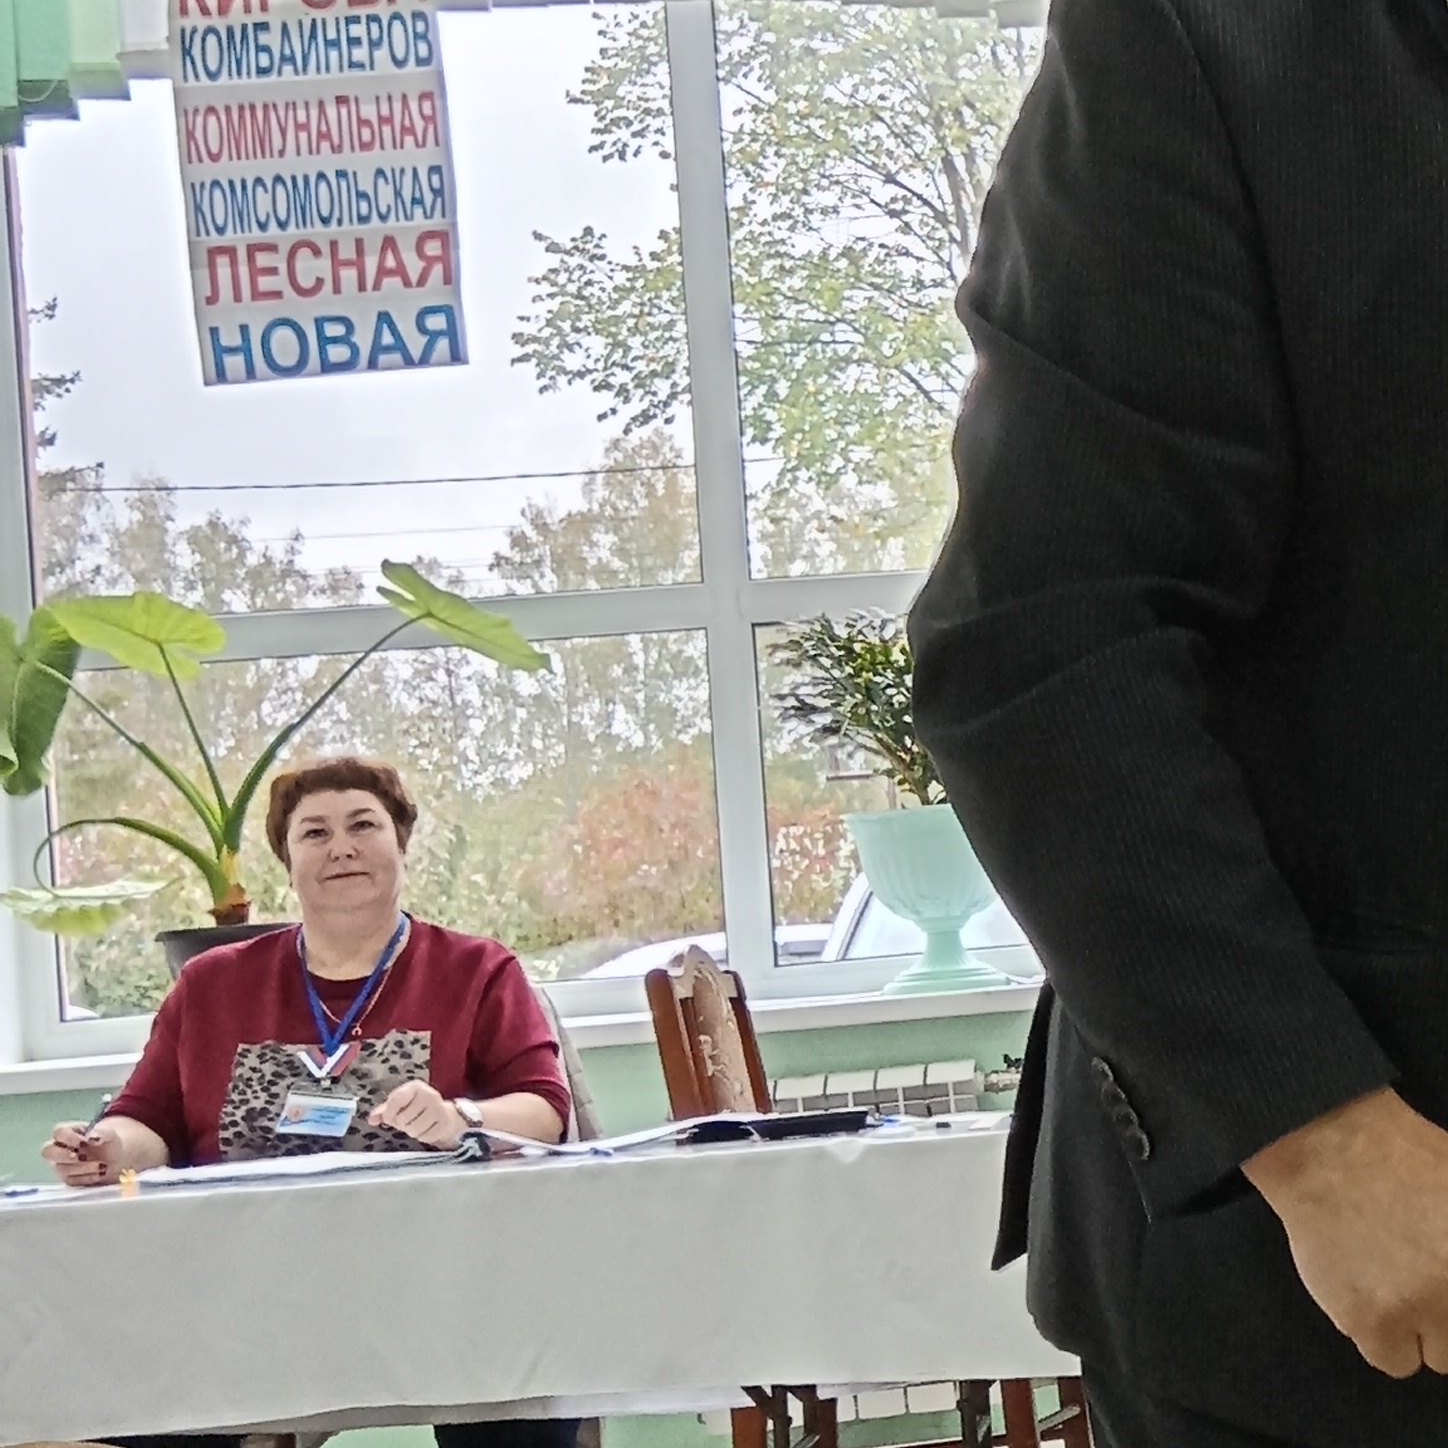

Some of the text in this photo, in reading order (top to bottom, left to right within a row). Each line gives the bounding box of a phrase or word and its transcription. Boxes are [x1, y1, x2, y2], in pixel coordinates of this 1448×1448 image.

[180, 10, 434, 83] КОМБАЙНЕРОВ
[184, 90, 441, 165] КОММУНАЛЬНАЯ
[190, 164, 447, 237] КОМСОМОЛЬСКАЯ
[204, 229, 453, 307] ЛЕСНАЯ
[208, 303, 463, 383] НОВАЯ
